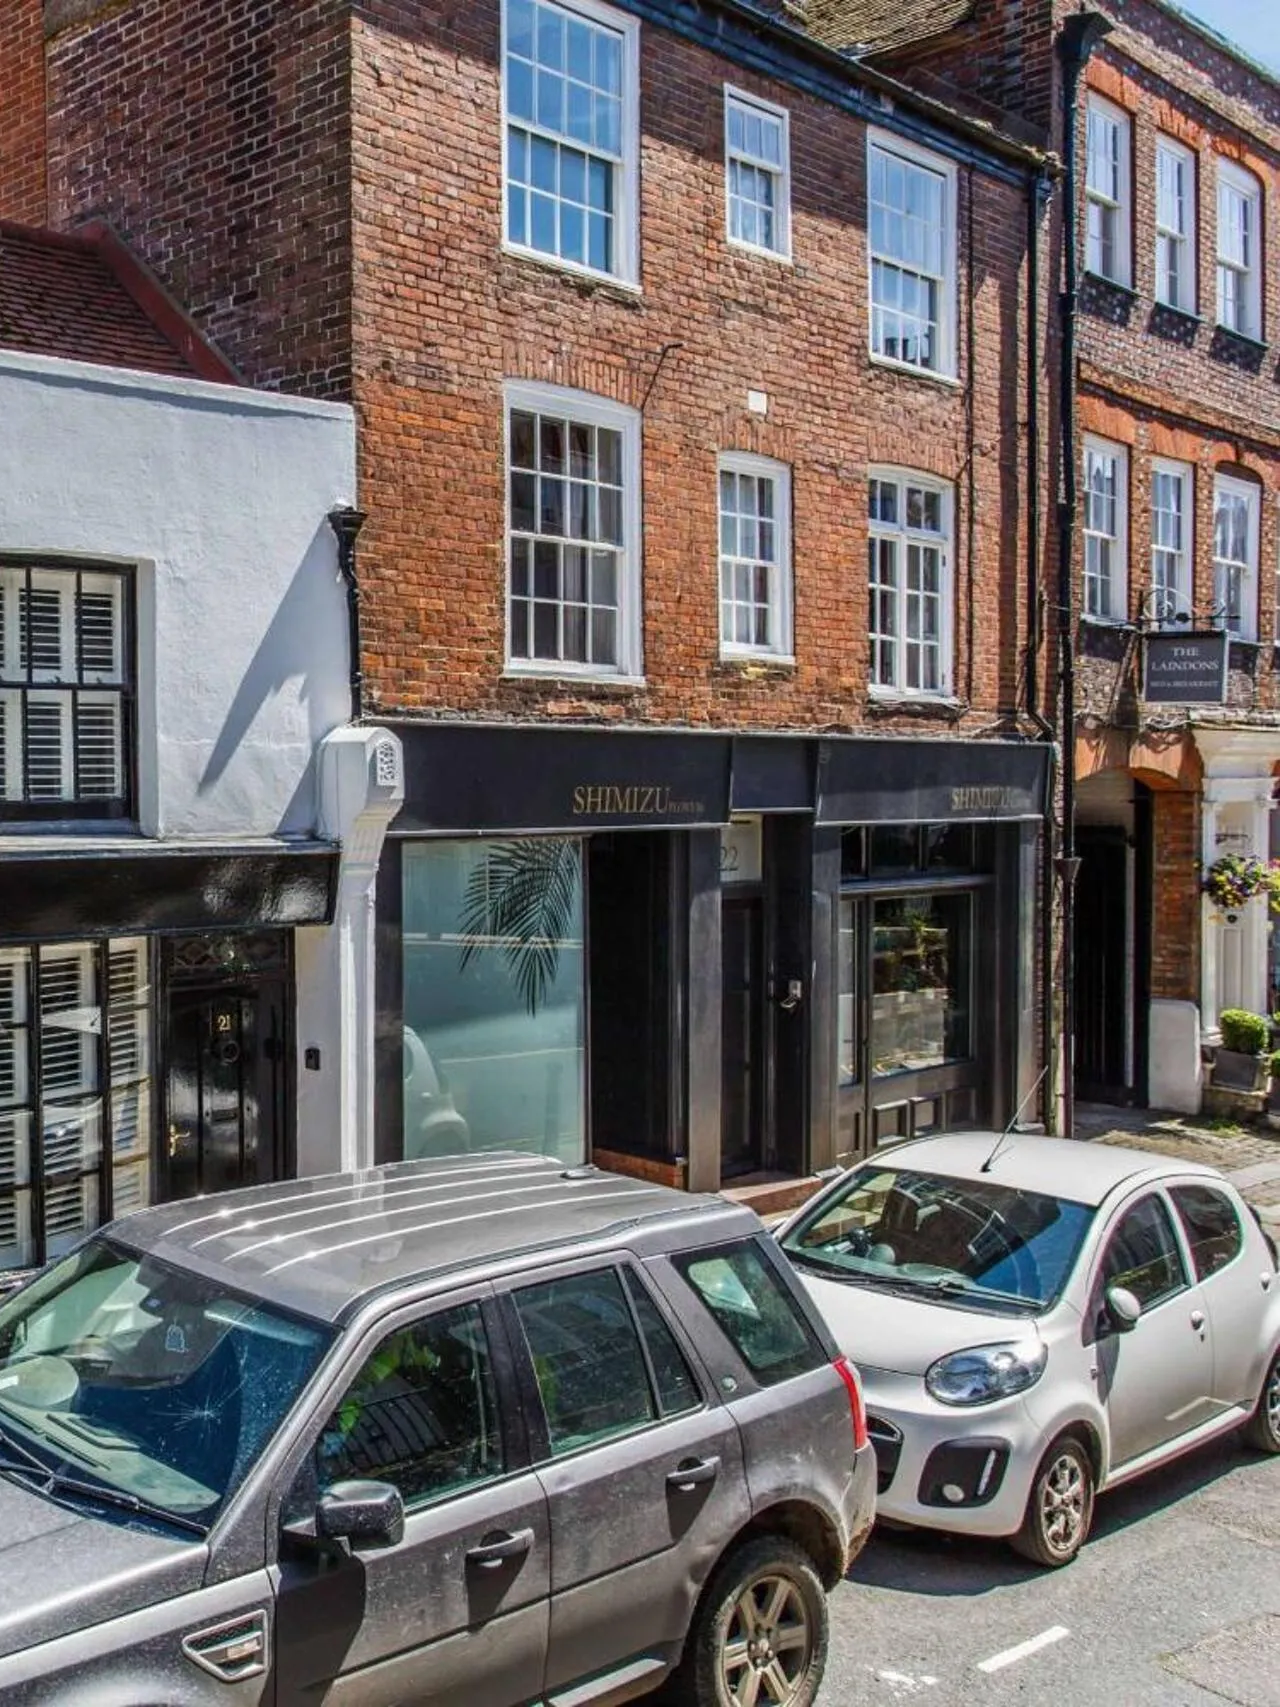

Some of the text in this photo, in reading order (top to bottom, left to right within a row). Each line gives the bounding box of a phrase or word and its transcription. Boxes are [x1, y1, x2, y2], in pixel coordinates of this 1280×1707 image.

[1172, 647, 1199, 657] THE
[573, 786, 671, 814] SHIMIZU
[719, 845, 739, 872] 22
[218, 1014, 231, 1031] 21
